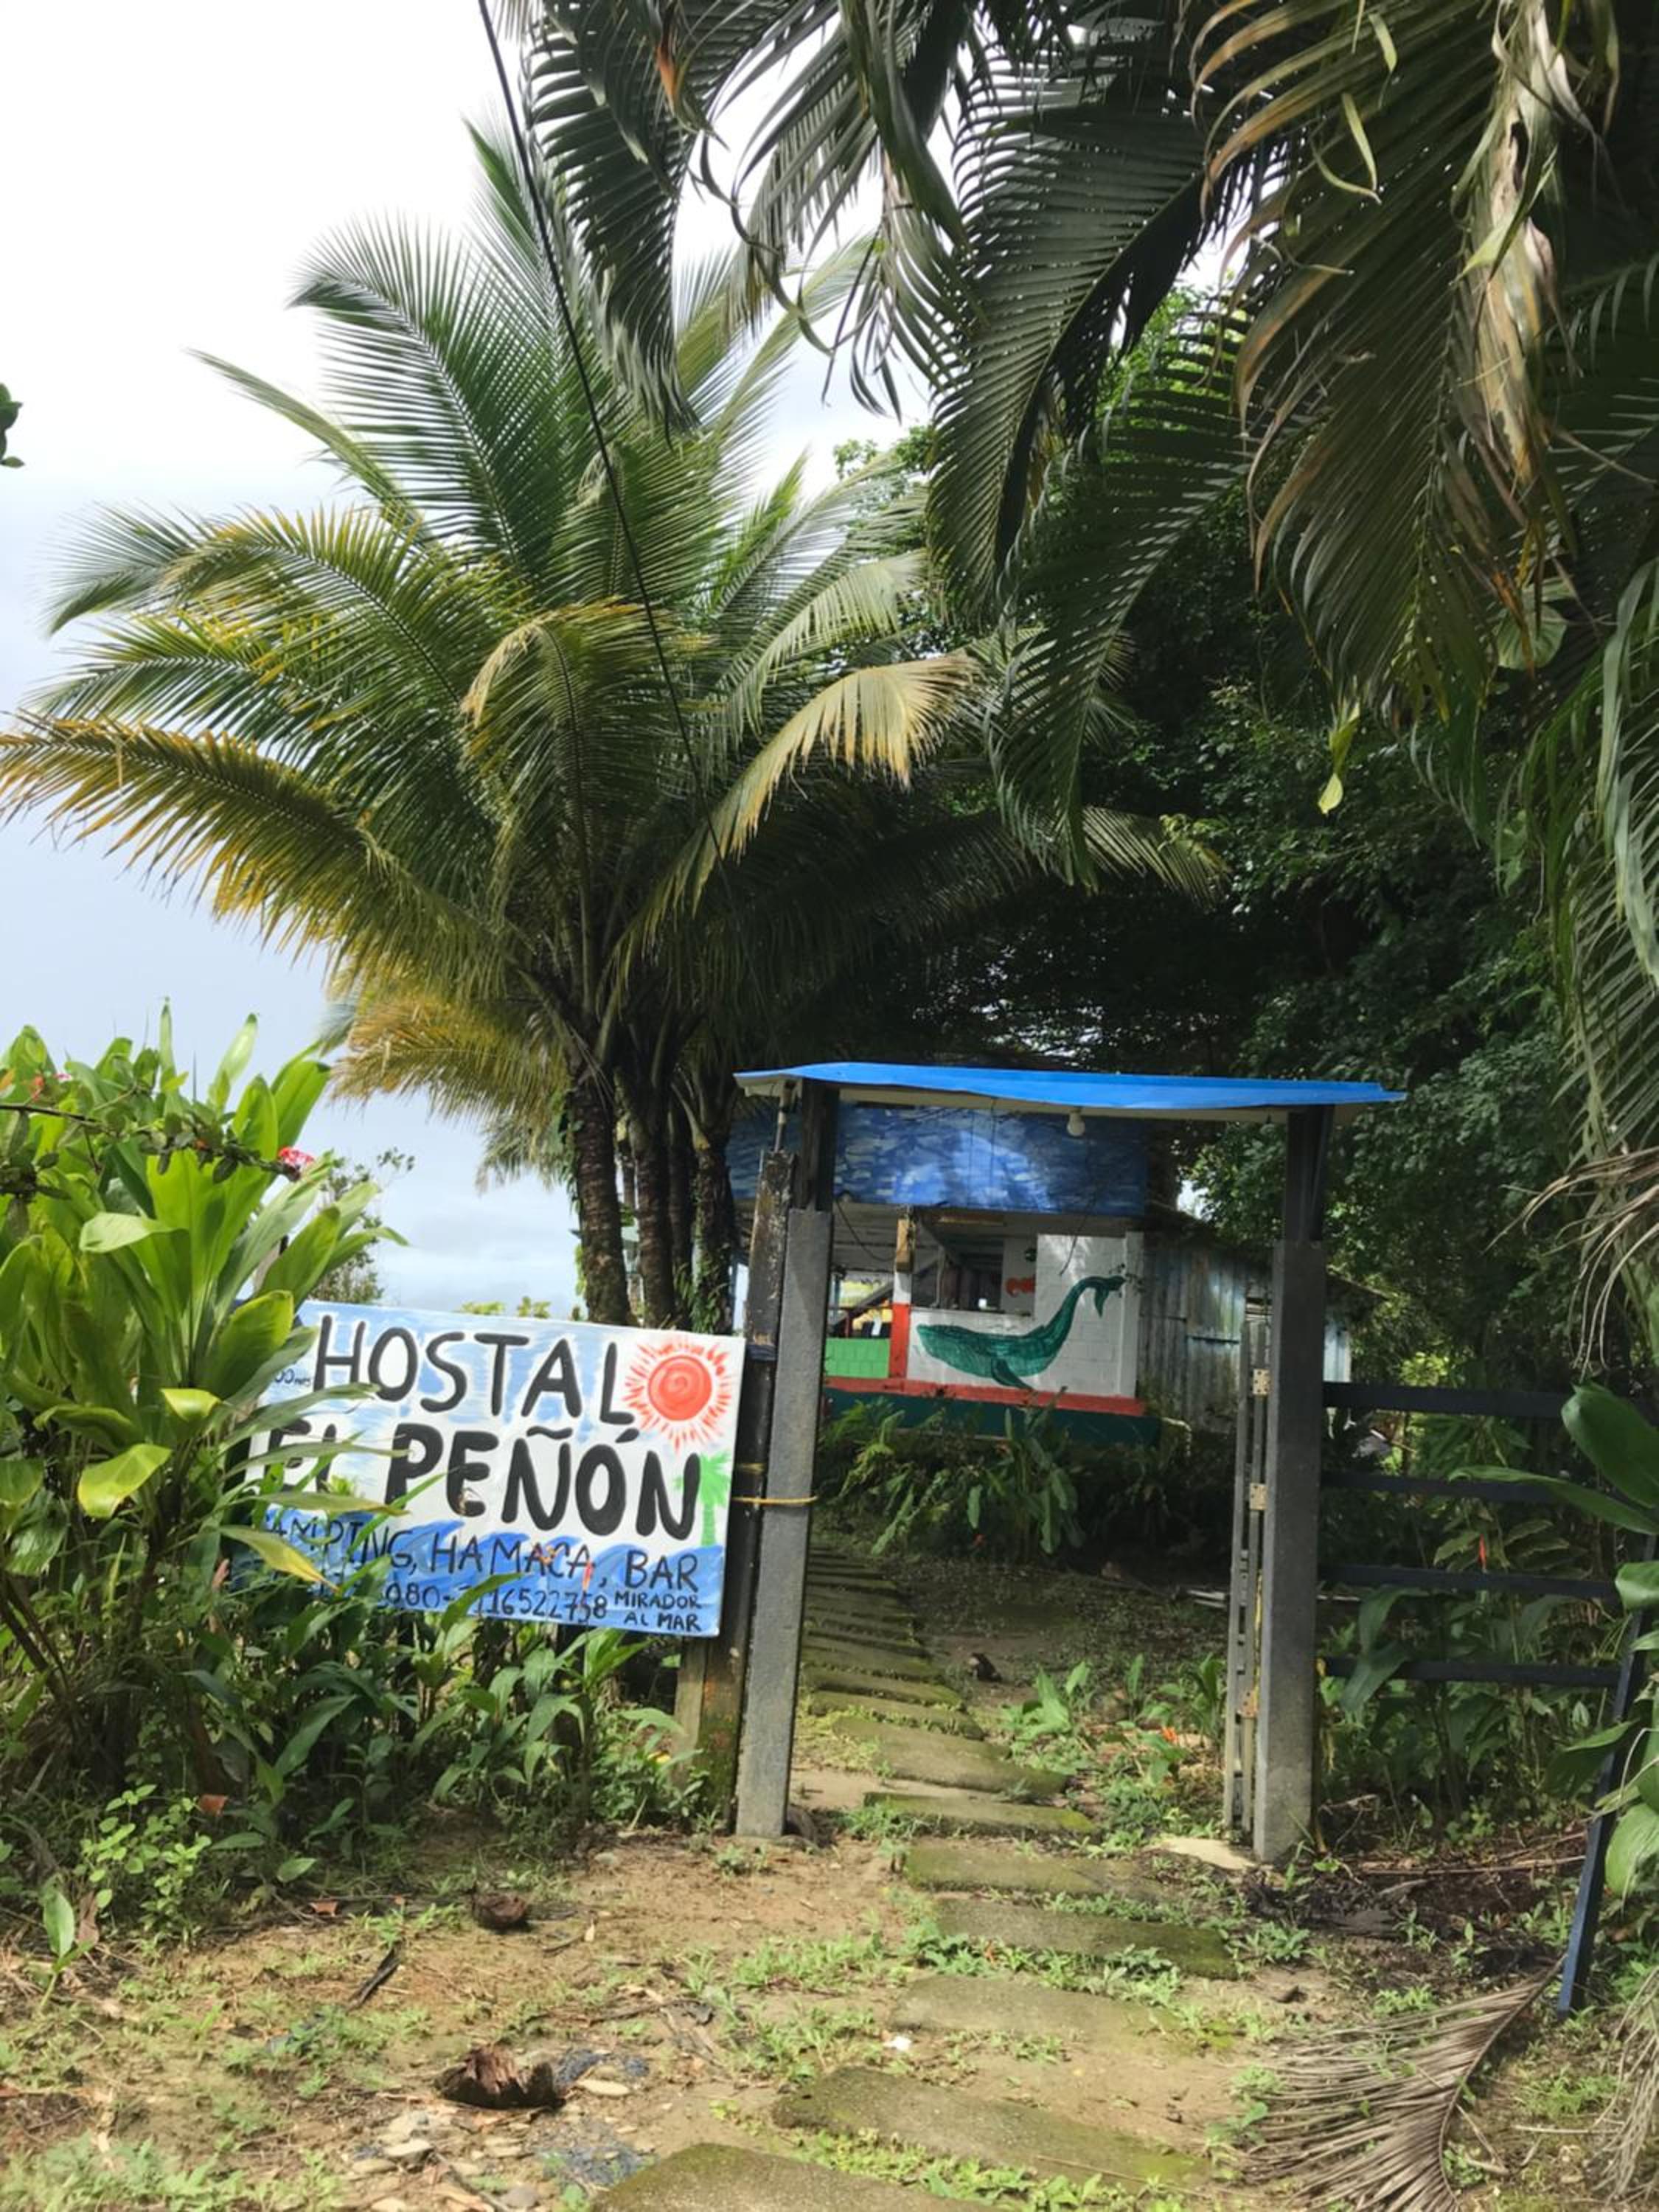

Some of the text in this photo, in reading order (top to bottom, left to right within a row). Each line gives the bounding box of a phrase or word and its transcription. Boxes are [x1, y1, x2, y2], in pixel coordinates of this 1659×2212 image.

[313, 1314, 636, 1425] HOSTAL
[385, 1422, 701, 1540] PEÑÓN
[625, 1549, 699, 1593] BAR
[614, 1590, 701, 1610] MIRADOR
[624, 1611, 702, 1632] AL MAR
